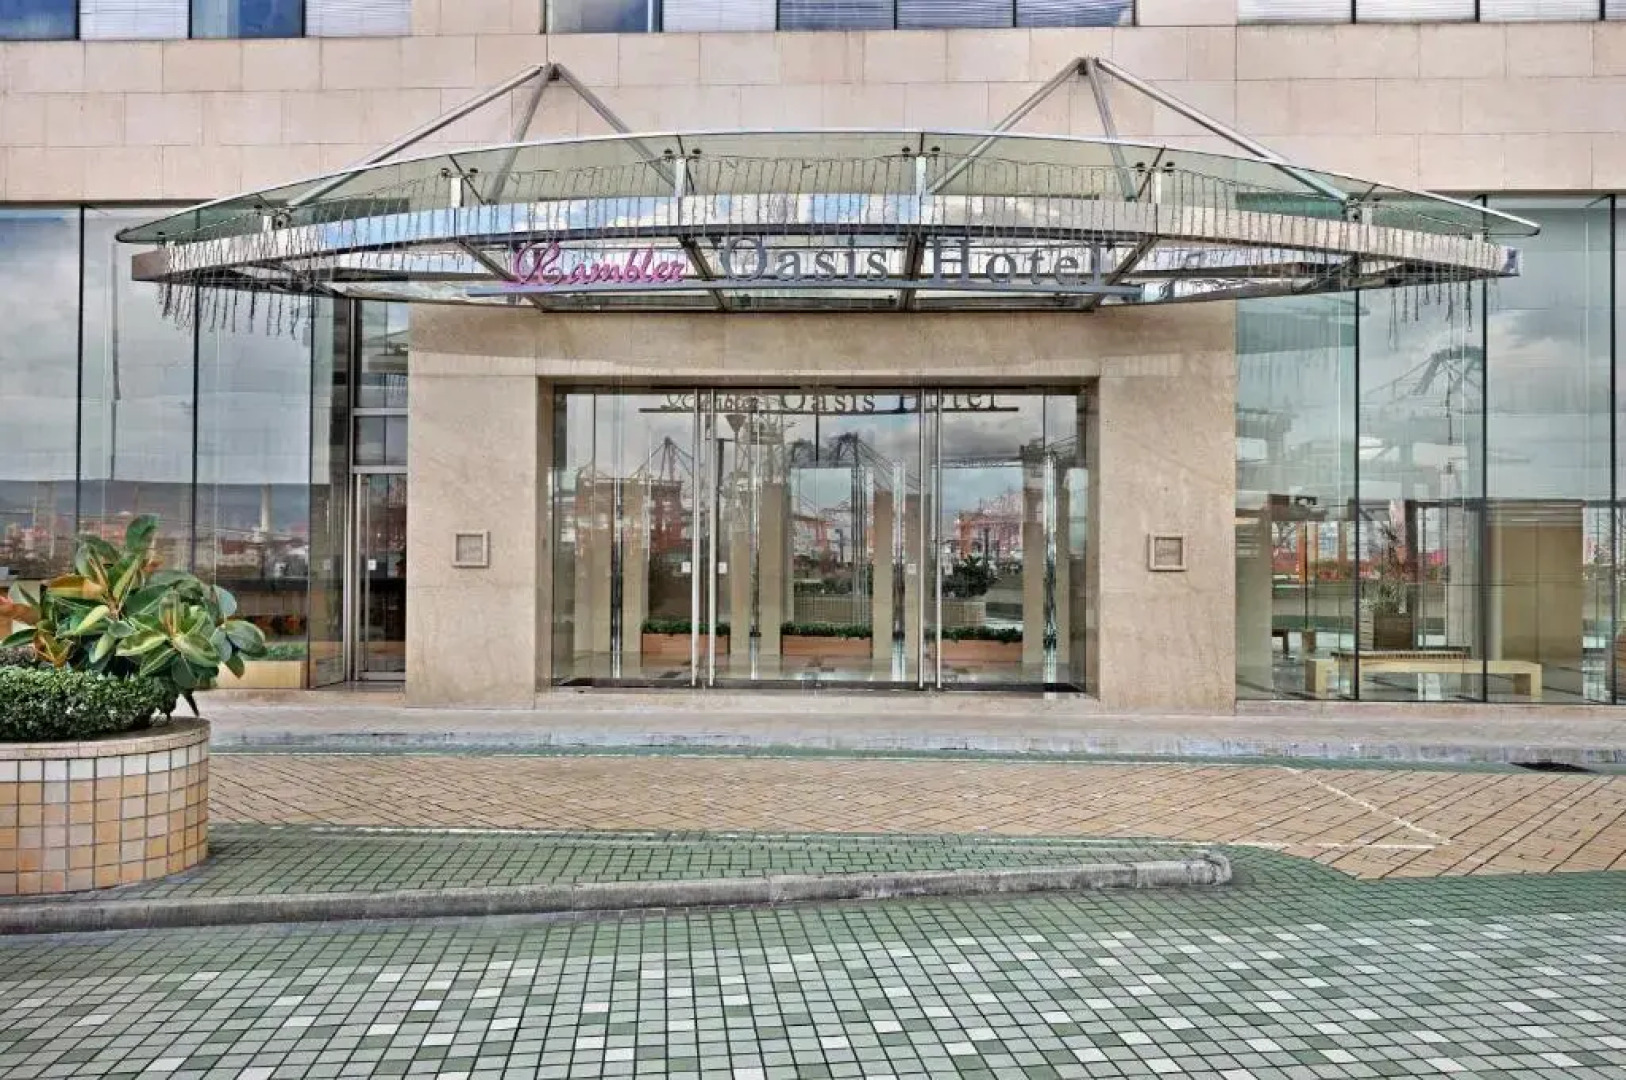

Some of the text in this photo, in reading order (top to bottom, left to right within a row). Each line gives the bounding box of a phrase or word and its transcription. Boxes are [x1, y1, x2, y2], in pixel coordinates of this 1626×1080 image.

[514, 236, 1102, 285] Rambler Oasis Hotel
